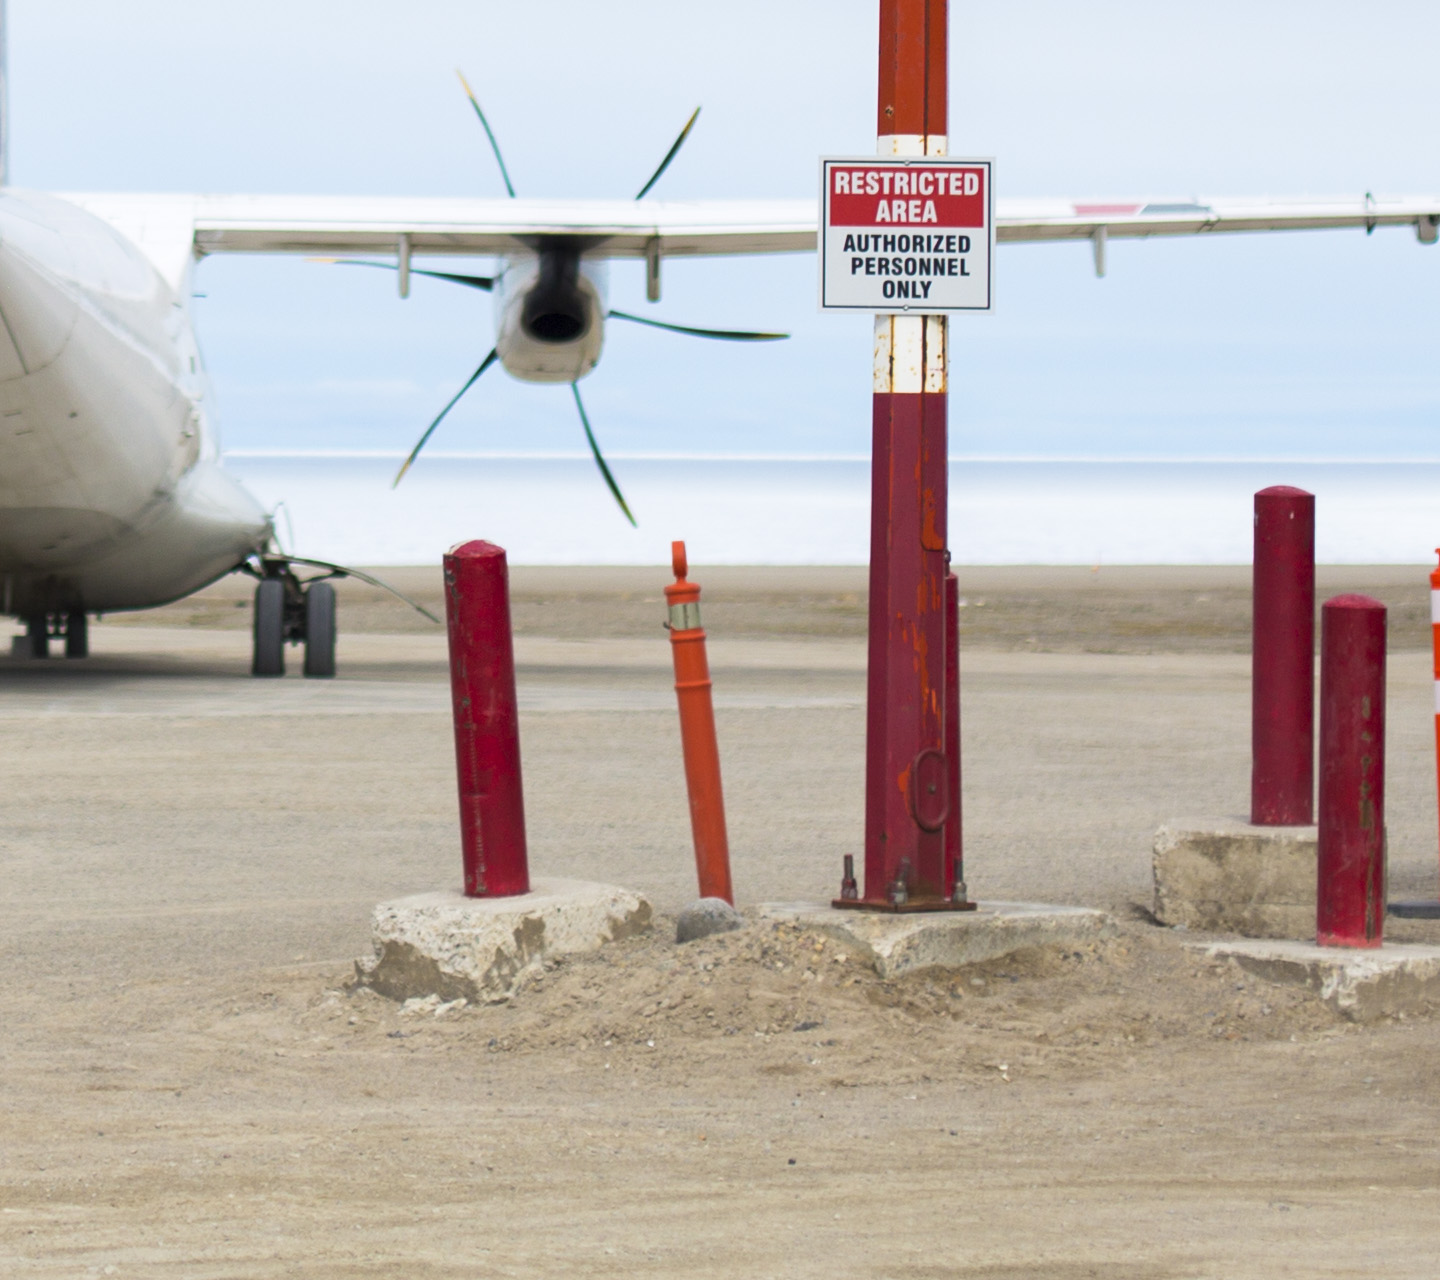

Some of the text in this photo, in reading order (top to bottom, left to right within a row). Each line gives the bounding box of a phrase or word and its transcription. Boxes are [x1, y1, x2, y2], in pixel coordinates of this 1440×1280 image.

[834, 171, 979, 196] RESTRICTED
[875, 199, 938, 223] AREA
[843, 234, 971, 253] AUTHORIZED
[851, 257, 970, 276] PERSONNEL
[882, 280, 933, 299] ONLY
